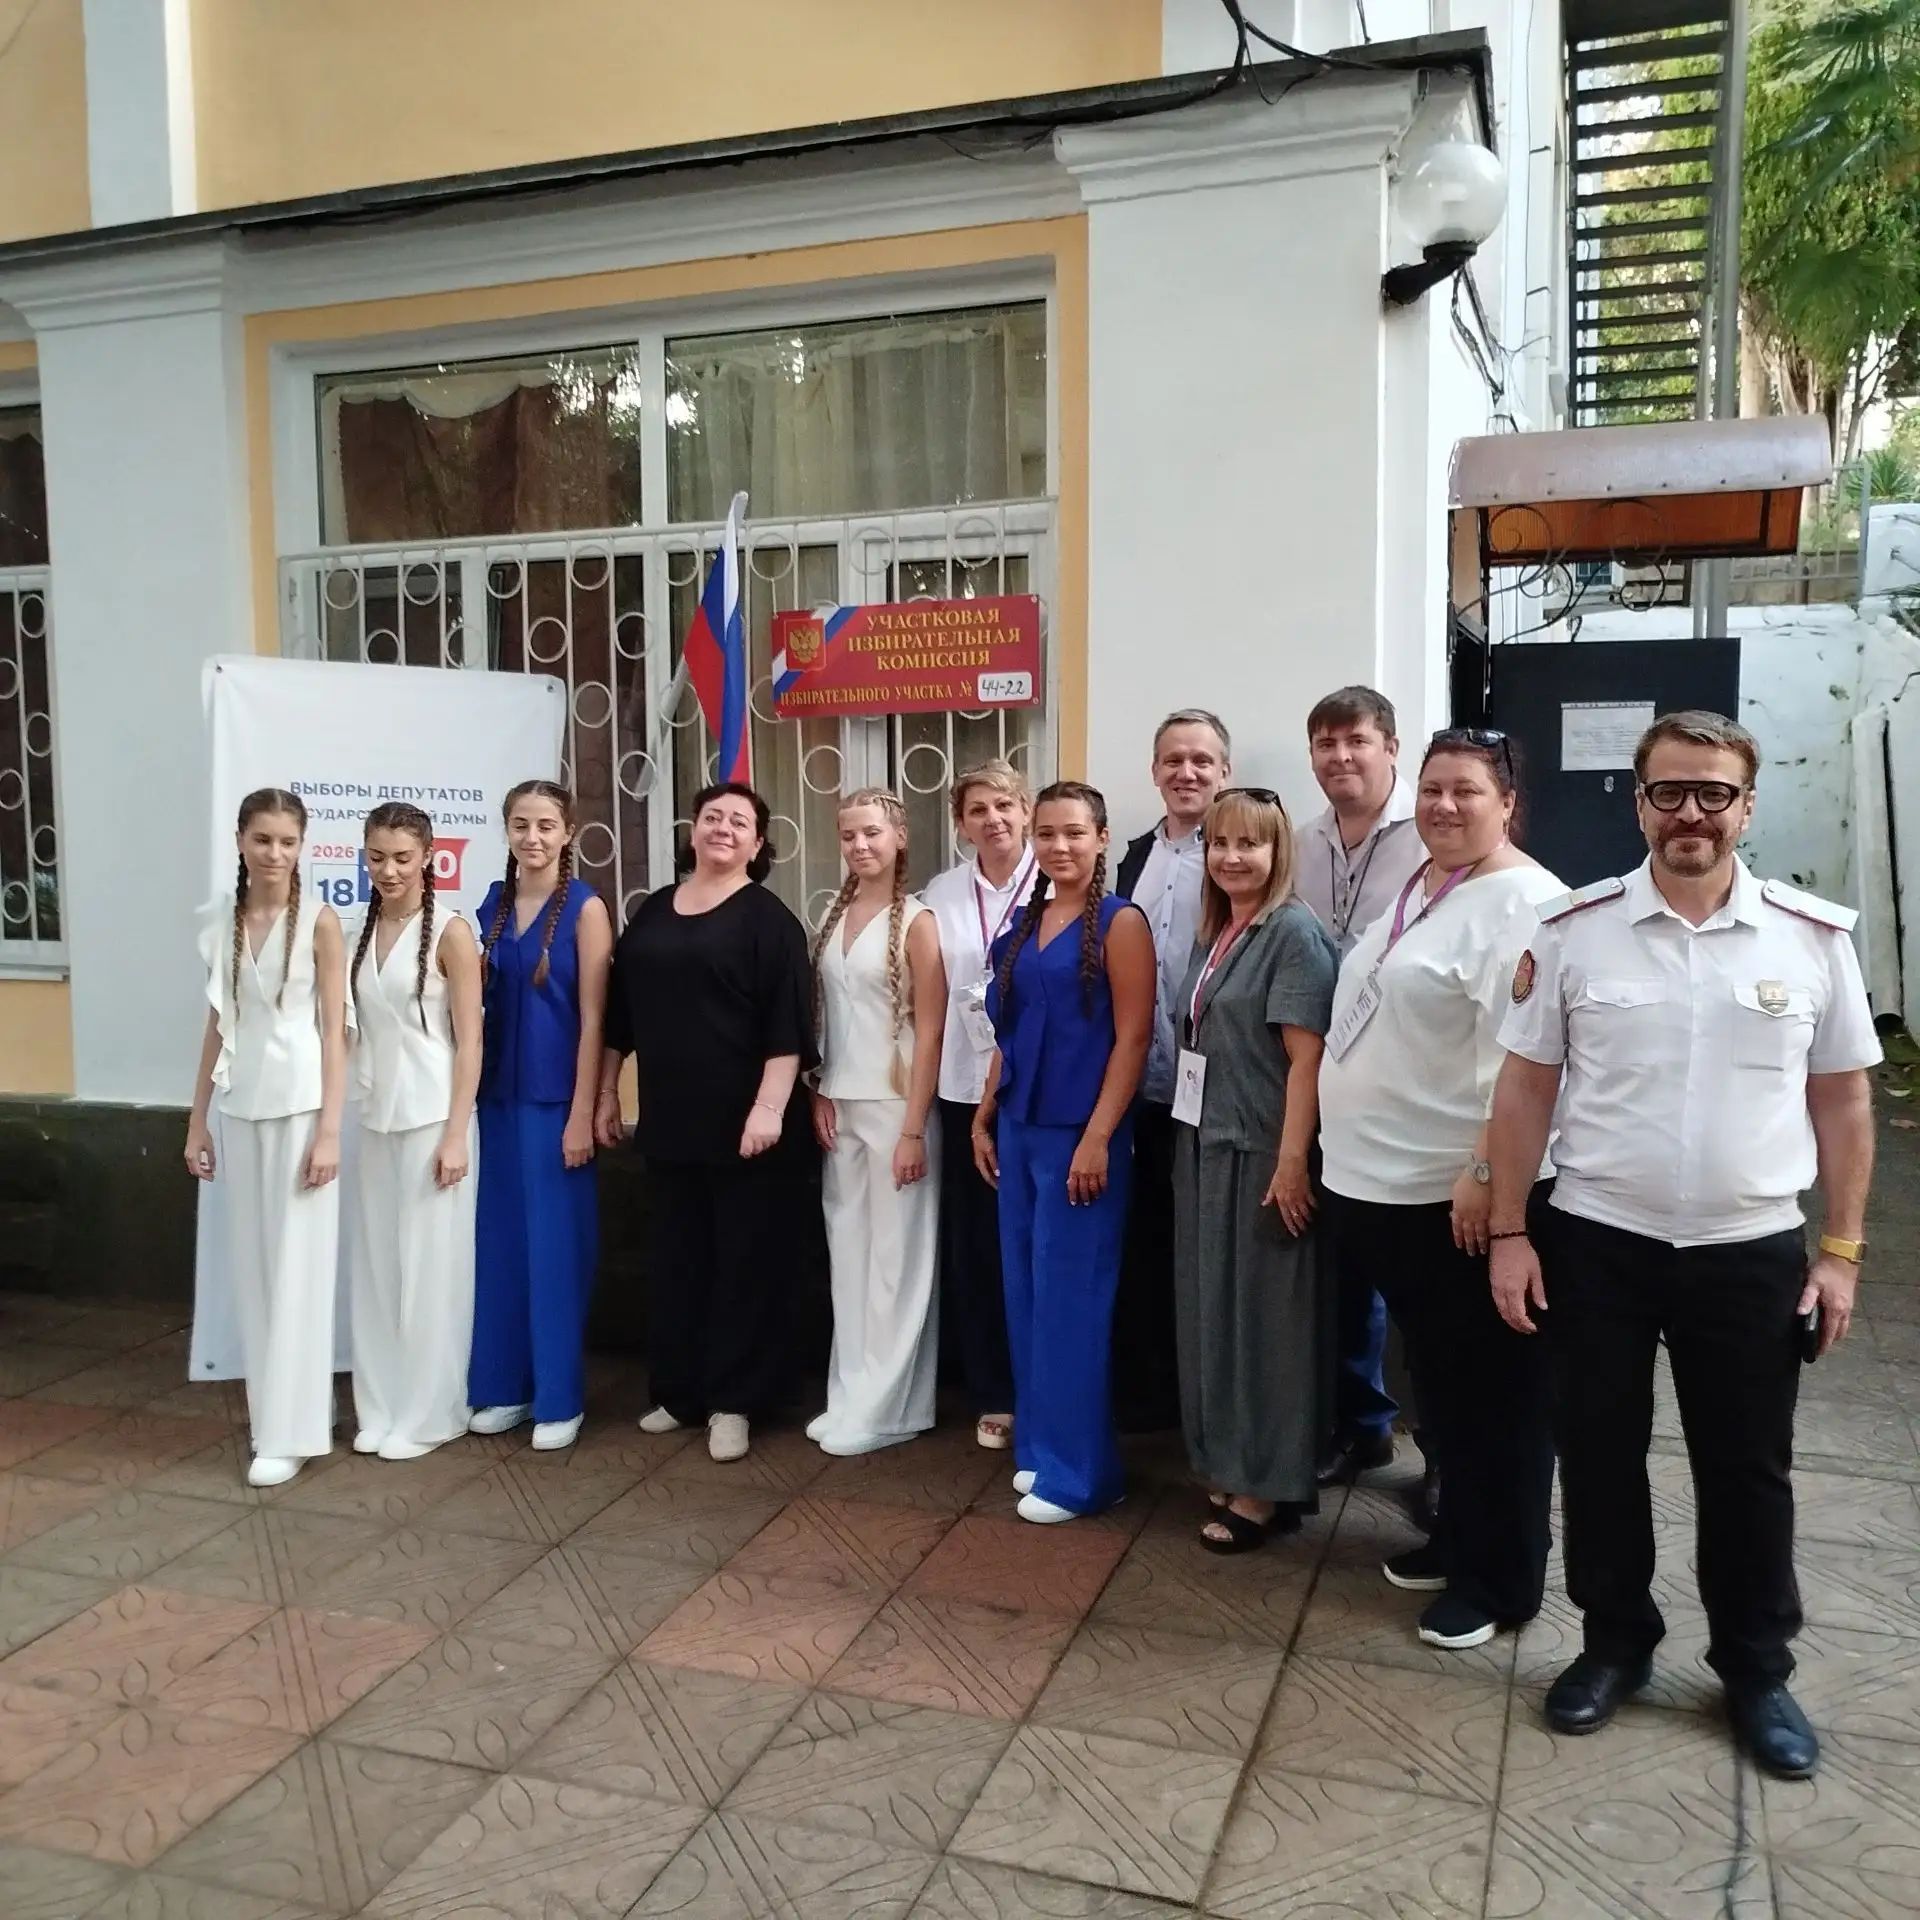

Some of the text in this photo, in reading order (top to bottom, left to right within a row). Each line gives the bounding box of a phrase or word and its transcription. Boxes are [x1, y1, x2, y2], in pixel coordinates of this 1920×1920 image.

[867, 608, 1000, 631] УЧАСТКОВАЯ
[848, 628, 1021, 652] ИЗБИРАТЕЛЬНАЯ
[877, 650, 990, 671] КОМИССИЯ
[780, 679, 972, 706] ИЗБИРАТЕЛЬНОГО УЧАСТКА №
[982, 680, 1025, 697] 44-22
[290, 782, 484, 802] ВЫБОРЫ ДЕПУТАТОВ
[441, 813, 487, 825] ДУМЫ
[312, 845, 354, 858] 2026
[317, 879, 354, 906] 18
